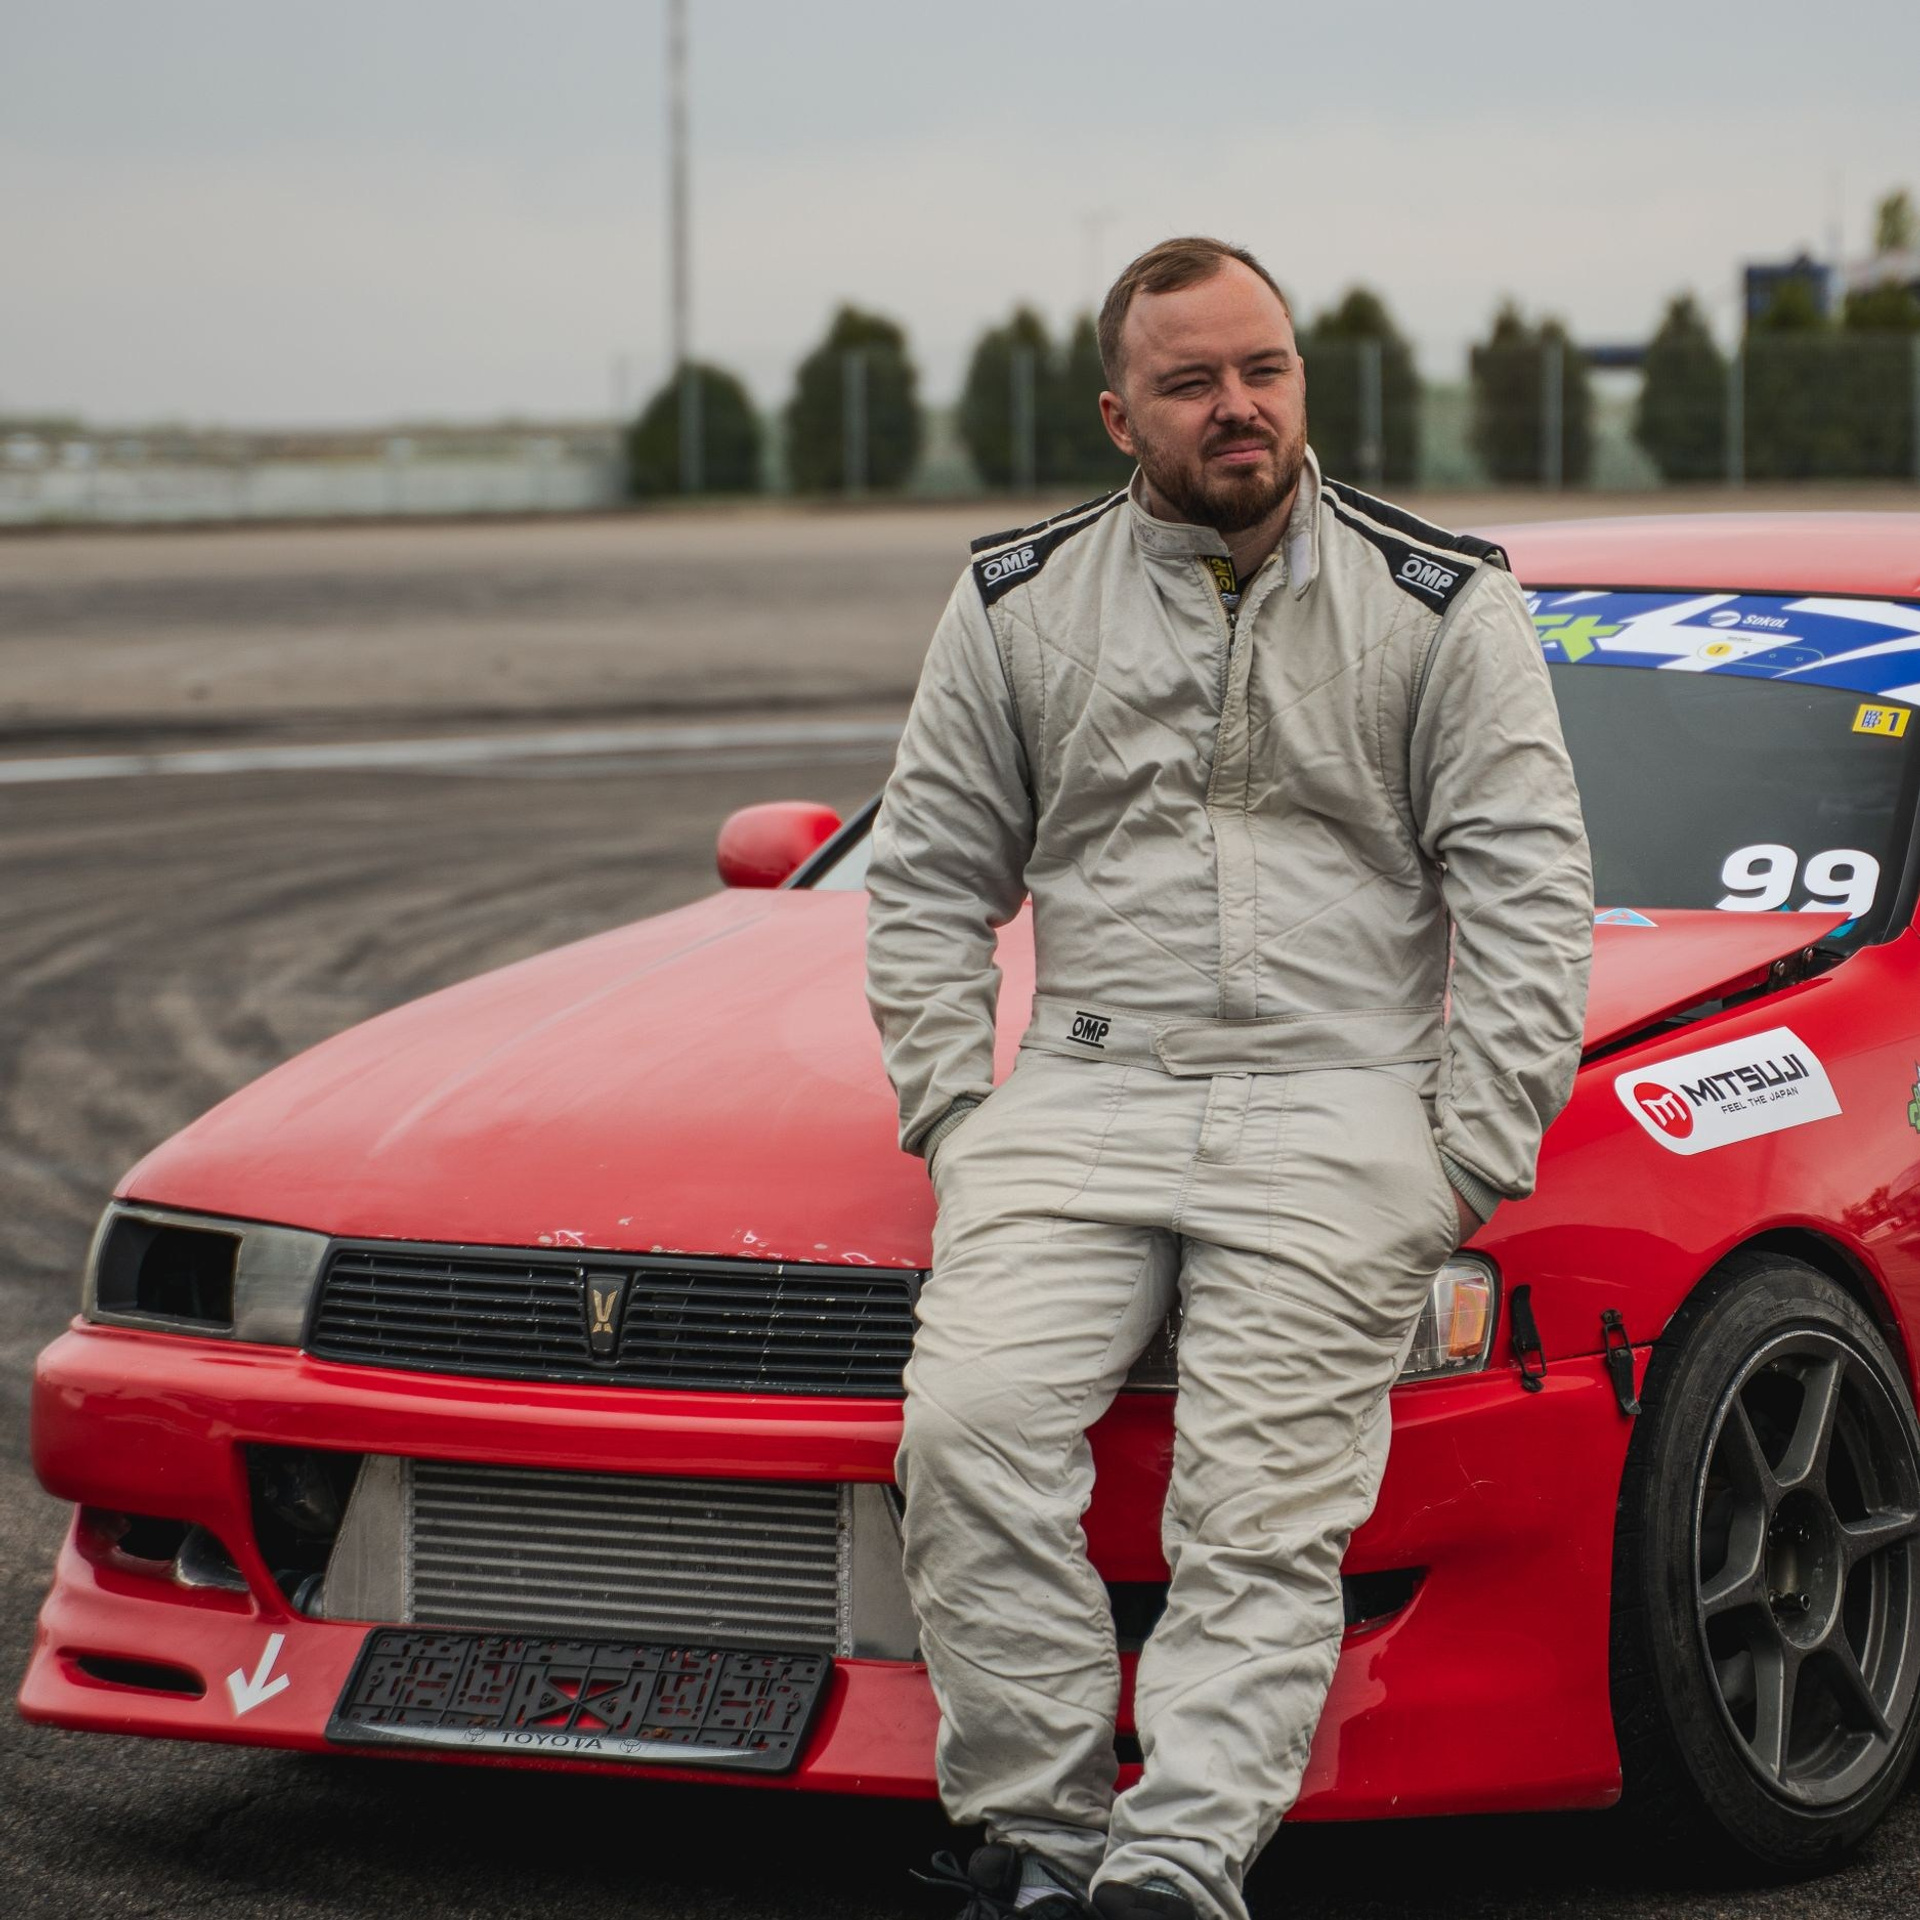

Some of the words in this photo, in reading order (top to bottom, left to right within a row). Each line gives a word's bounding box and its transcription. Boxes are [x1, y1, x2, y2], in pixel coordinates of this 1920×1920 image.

[984, 549, 1035, 581] OMP
[1401, 559, 1454, 590] OMP
[1715, 843, 1881, 921] 99
[1072, 1016, 1109, 1042] OMP
[1680, 1053, 1810, 1107] MITSUJI
[1721, 1102, 1747, 1115] FEEL
[1747, 1095, 1768, 1107] THE
[1769, 1086, 1799, 1101] JAPAN
[500, 1732, 603, 1750] TOYOTA
